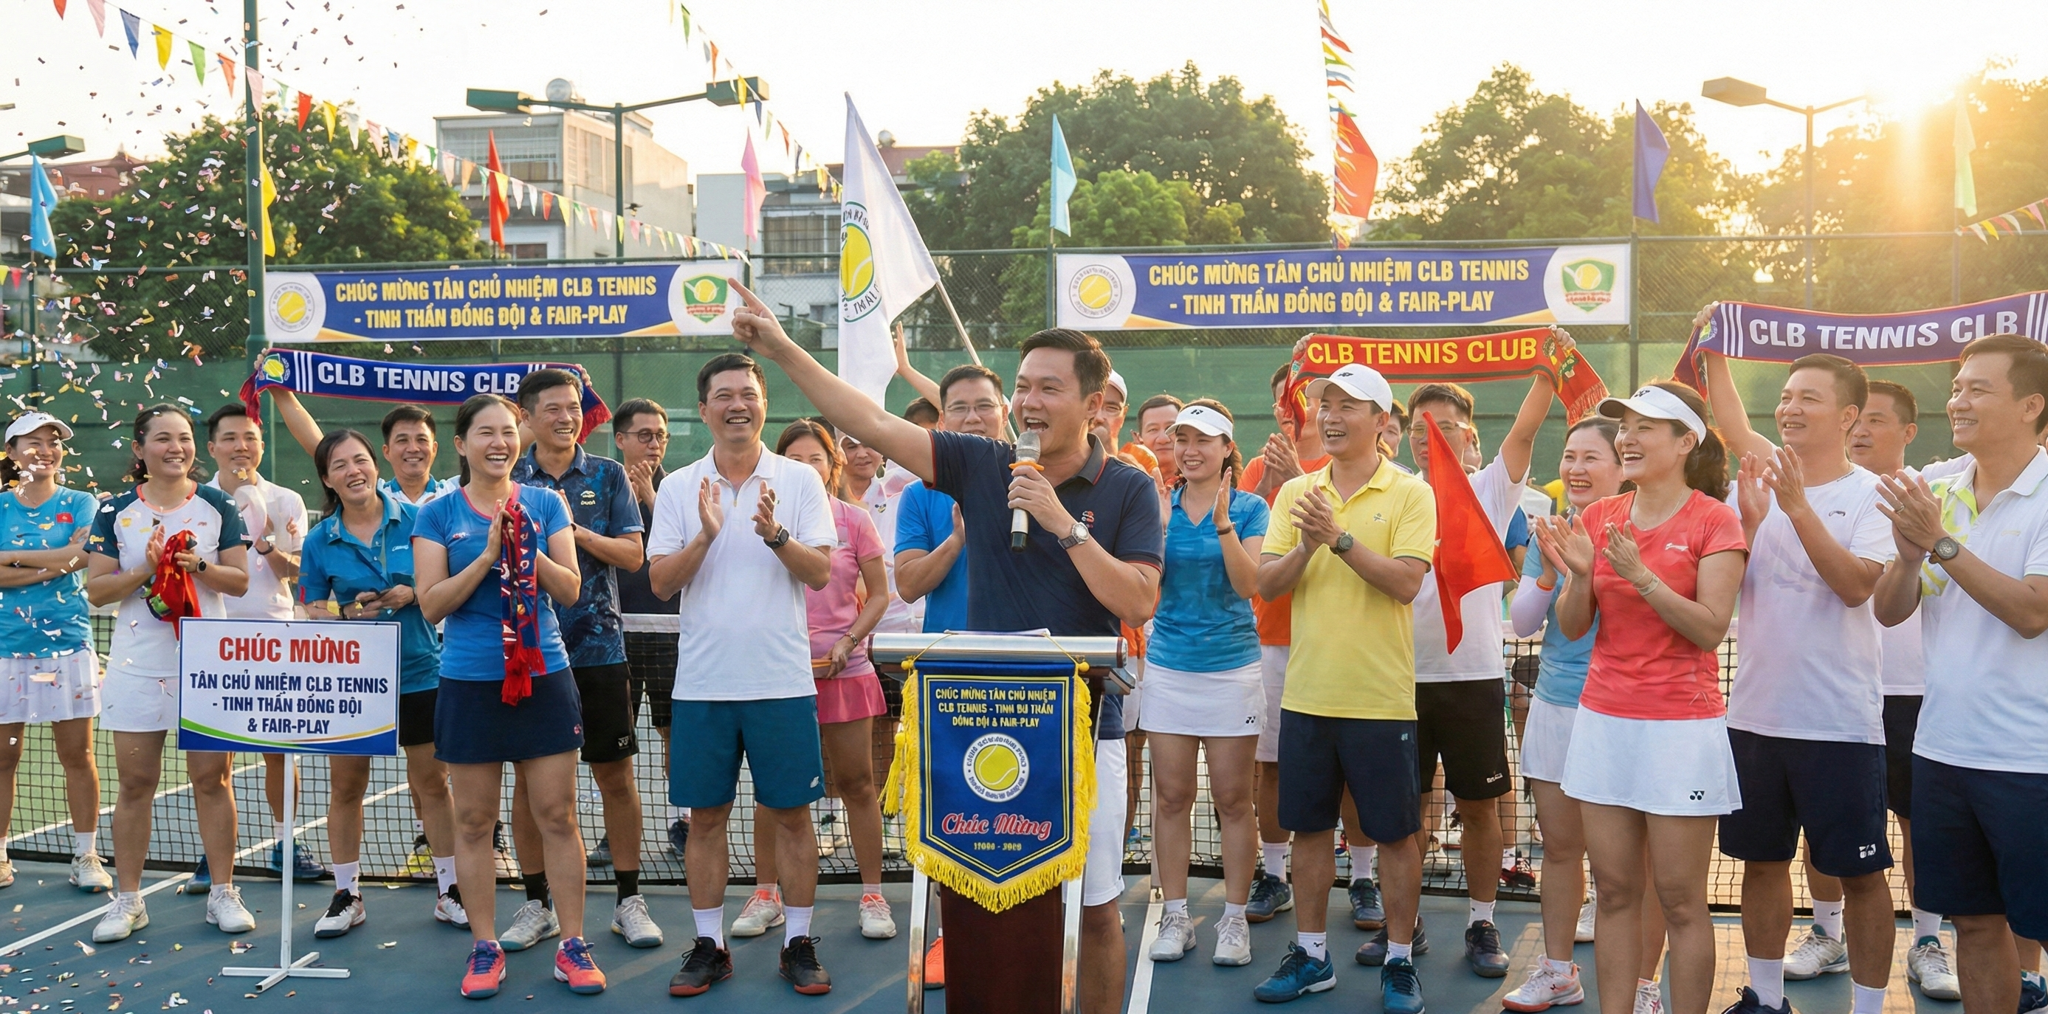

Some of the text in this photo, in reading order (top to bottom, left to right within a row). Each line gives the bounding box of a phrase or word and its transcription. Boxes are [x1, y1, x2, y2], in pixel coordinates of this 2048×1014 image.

[1149, 255, 1529, 286] CHÚC MỪNG TÂN CHỦ NHIỆM CLB TENNIS
[335, 273, 657, 302] CHÚC MỪNG TÂN CHỦ NHIỆM CLB TENNIS
[1183, 294, 1226, 315] TINH
[1341, 287, 1373, 317] ĐỘI
[1378, 291, 1393, 313] &
[1398, 290, 1495, 313] FAIR-PLAY
[365, 309, 402, 329] TINH
[498, 303, 525, 330] ĐỘI
[530, 306, 543, 326] &
[546, 305, 629, 326] FAIR-PLAY
[1749, 318, 1806, 348] CLB
[1816, 321, 1940, 350] TENNIS
[1307, 342, 1355, 365] CLB
[1360, 341, 1459, 365] TENNIS
[1467, 337, 1537, 363] CLUB
[317, 361, 366, 387] CLB
[373, 365, 466, 393] TENNIS
[473, 371, 520, 395] CLB
[219, 633, 361, 665] CHÚC MỪNG
[190, 670, 218, 689] TÂN
[222, 669, 251, 690] CHỦ
[306, 676, 332, 692] CLB
[336, 677, 389, 694] TENNIS
[222, 696, 253, 712] TINH
[339, 696, 362, 718] ĐỘI
[938, 702, 954, 713] CLB
[956, 702, 988, 713] TENNIS
[247, 717, 330, 735] & FAIR-PLAY
[941, 812, 990, 835] Chúc
